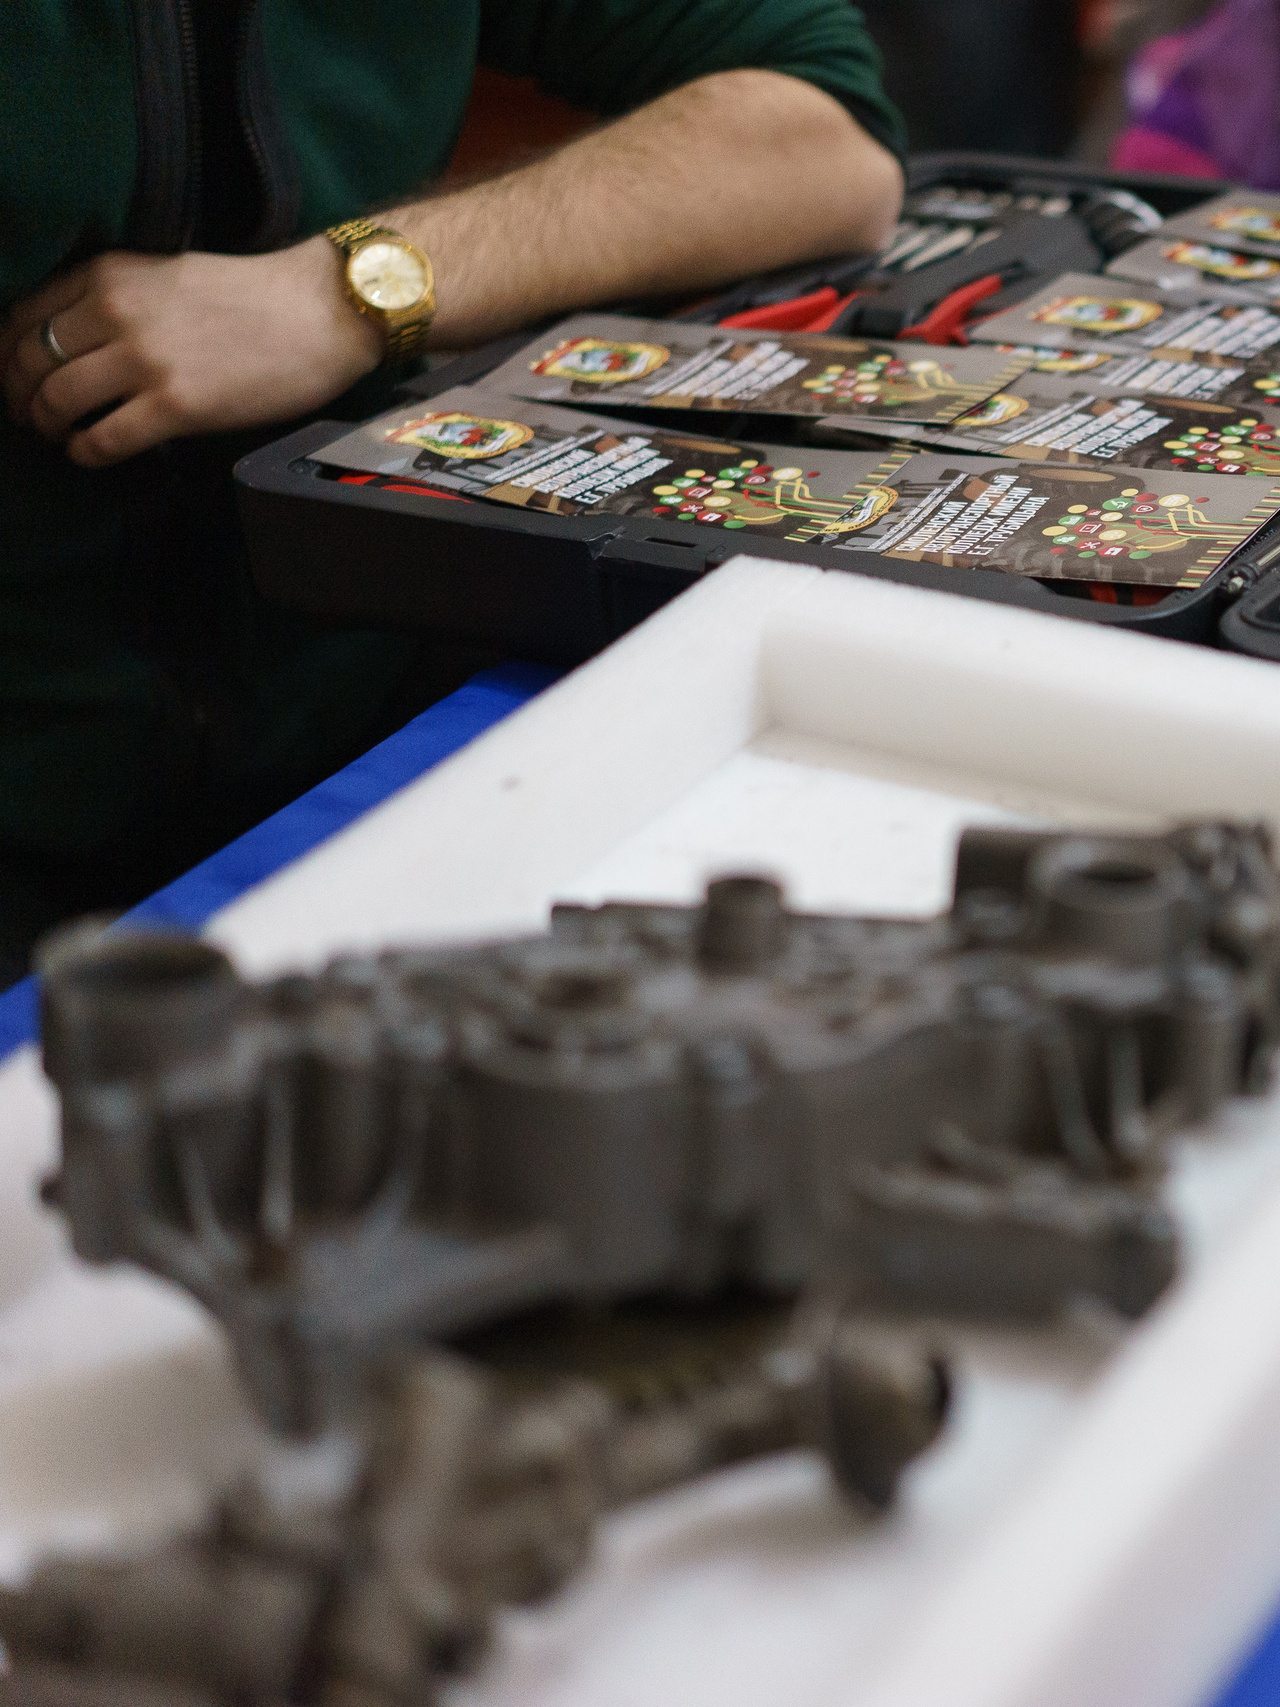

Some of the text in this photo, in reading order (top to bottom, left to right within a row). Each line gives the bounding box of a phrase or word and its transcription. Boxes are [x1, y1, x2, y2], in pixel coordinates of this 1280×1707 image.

[895, 501, 970, 552] СМОЛЕНСКИЙ
[919, 474, 1020, 553] АВТОТРАНСПОРТНЫЙ
[943, 516, 1004, 554] КОЛЛЕДЖ
[988, 486, 1033, 516] ИМЕНИ
[983, 496, 1051, 543] ТРУБИЦЫНА
